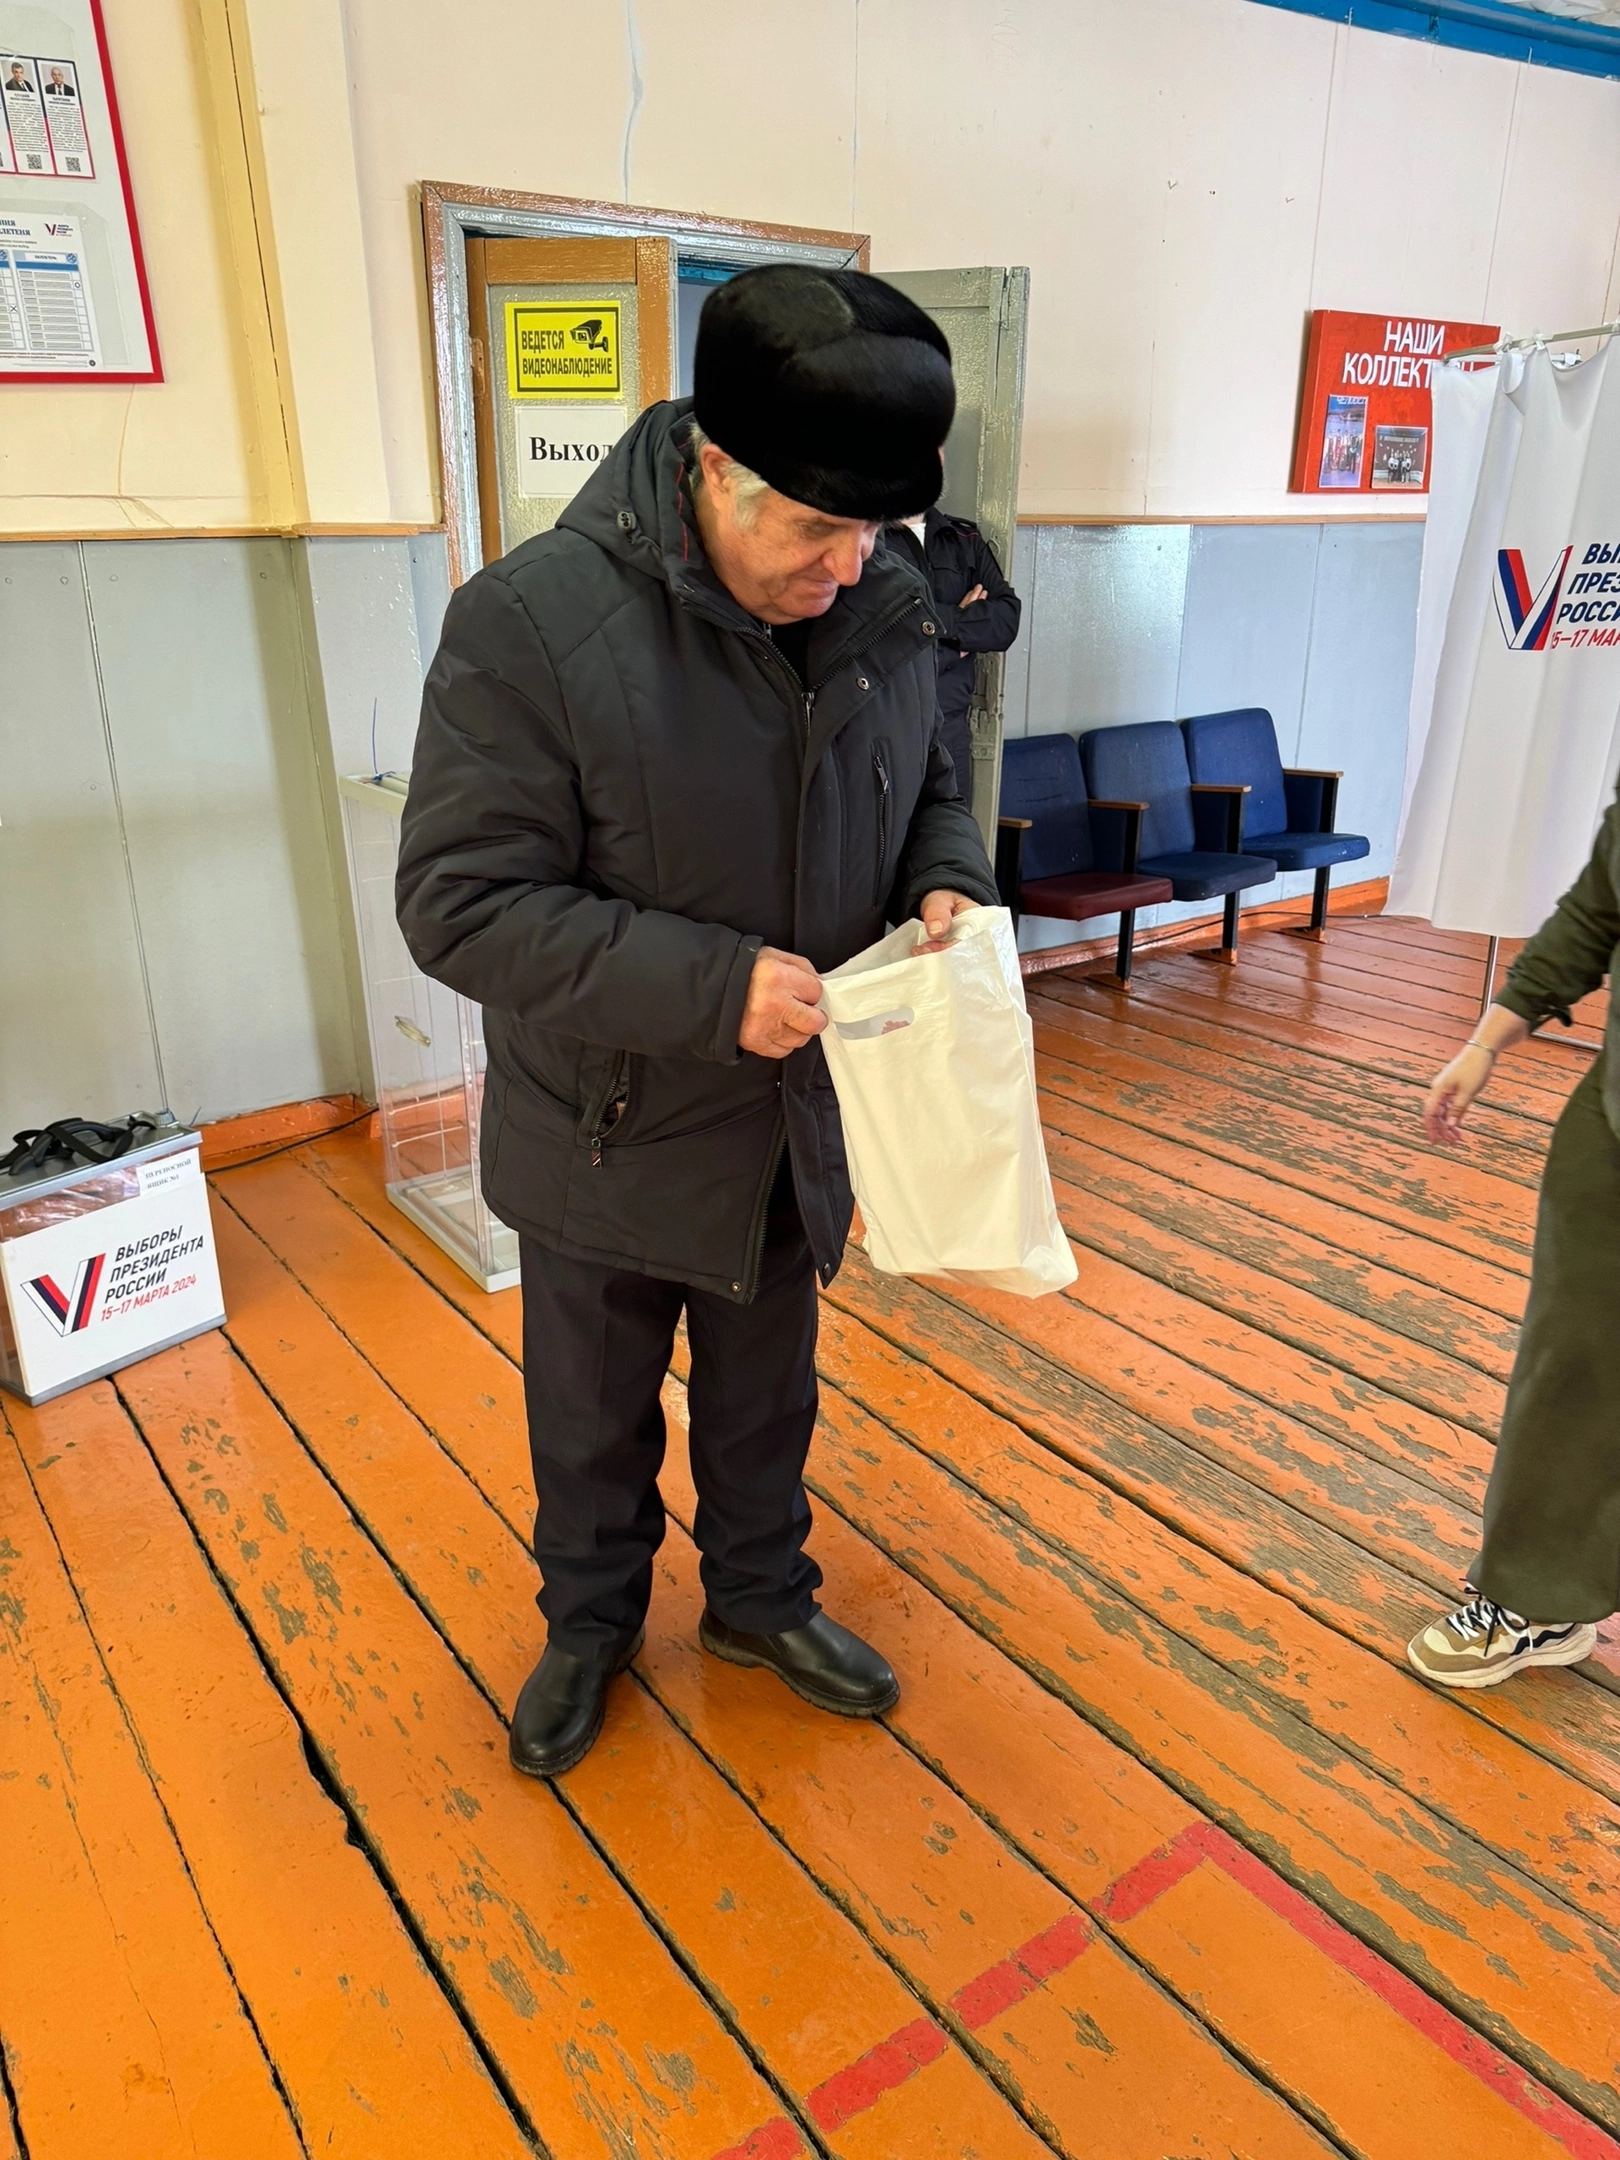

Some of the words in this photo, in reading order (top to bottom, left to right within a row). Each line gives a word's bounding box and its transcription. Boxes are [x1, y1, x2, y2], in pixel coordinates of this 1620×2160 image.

[521, 330, 565, 353] ВЕДЕТСЯ
[1384, 321, 1445, 355] НАШИ
[522, 357, 613, 377] ВИДЕОНАБЛЮДЕНИЕ
[1341, 353, 1474, 388] КОЛЛЕКТ
[110, 1235, 204, 1283] ПРЕЗИДЕНТА
[115, 1225, 183, 1262] ВЫБОРЫ
[105, 1267, 167, 1304] РОССИИ
[133, 1284, 170, 1309] МАРТА
[171, 1273, 197, 1294] 2024
